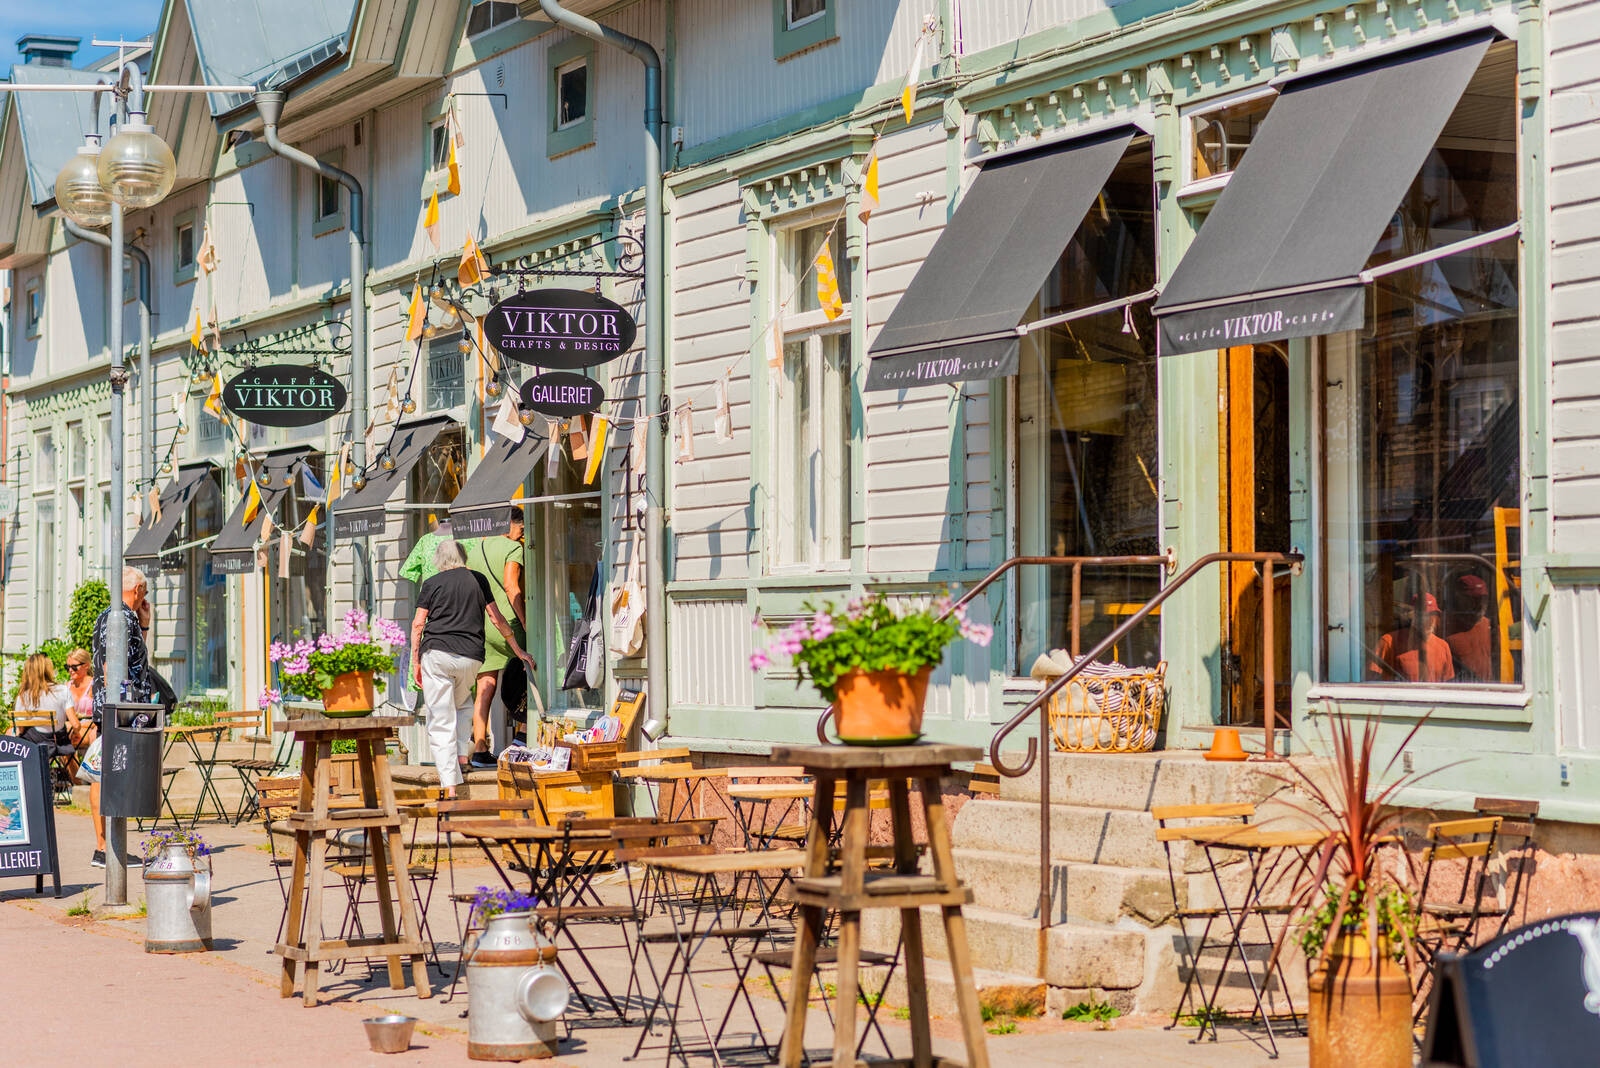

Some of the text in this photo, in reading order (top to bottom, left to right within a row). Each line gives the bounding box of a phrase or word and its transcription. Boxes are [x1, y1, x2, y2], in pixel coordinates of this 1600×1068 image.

[501, 311, 620, 336] VIKTOR
[1185, 310, 1328, 341] CAFÉ VIKTOR CAFÉ
[501, 339, 620, 351] CRAFTS & DESIGN
[886, 357, 993, 380] CAFÉ VIKTOR CAFÉ
[254, 377, 317, 385] CAFÉ
[235, 388, 335, 407] VIKTOR
[532, 384, 593, 404] GALLERIET
[469, 518, 492, 532] VIKTOR
[0, 740, 30, 758] OPEN
